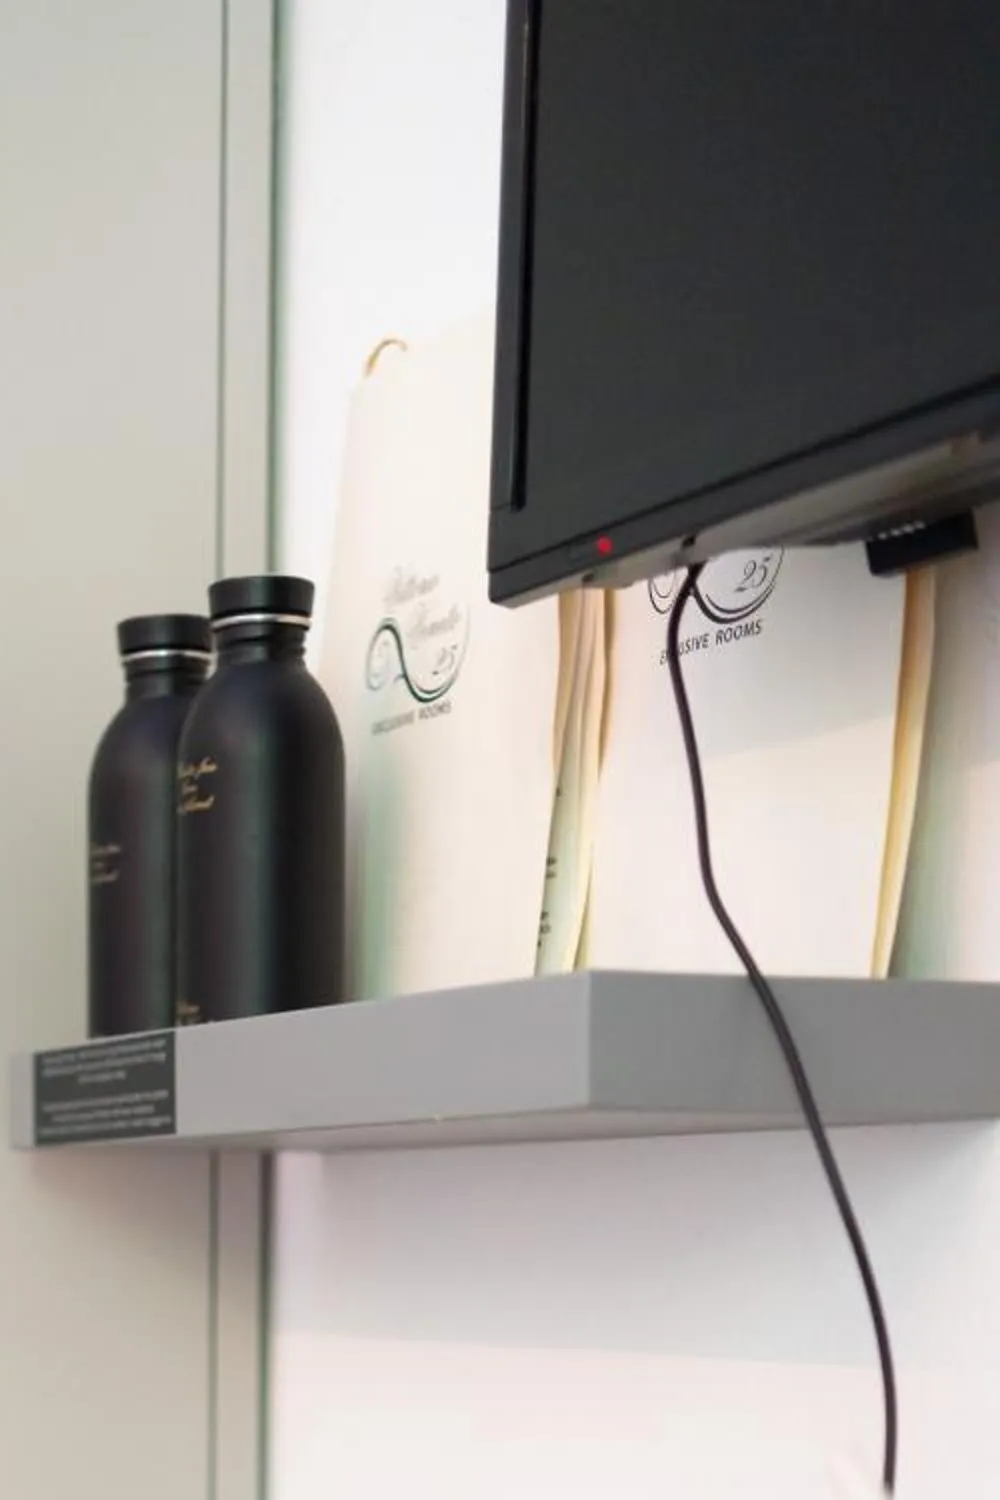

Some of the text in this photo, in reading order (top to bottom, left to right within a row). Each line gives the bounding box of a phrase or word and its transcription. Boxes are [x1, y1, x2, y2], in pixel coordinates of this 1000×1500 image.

[735, 553, 773, 593] 25
[659, 620, 763, 666] EUSIVE ROOMS
